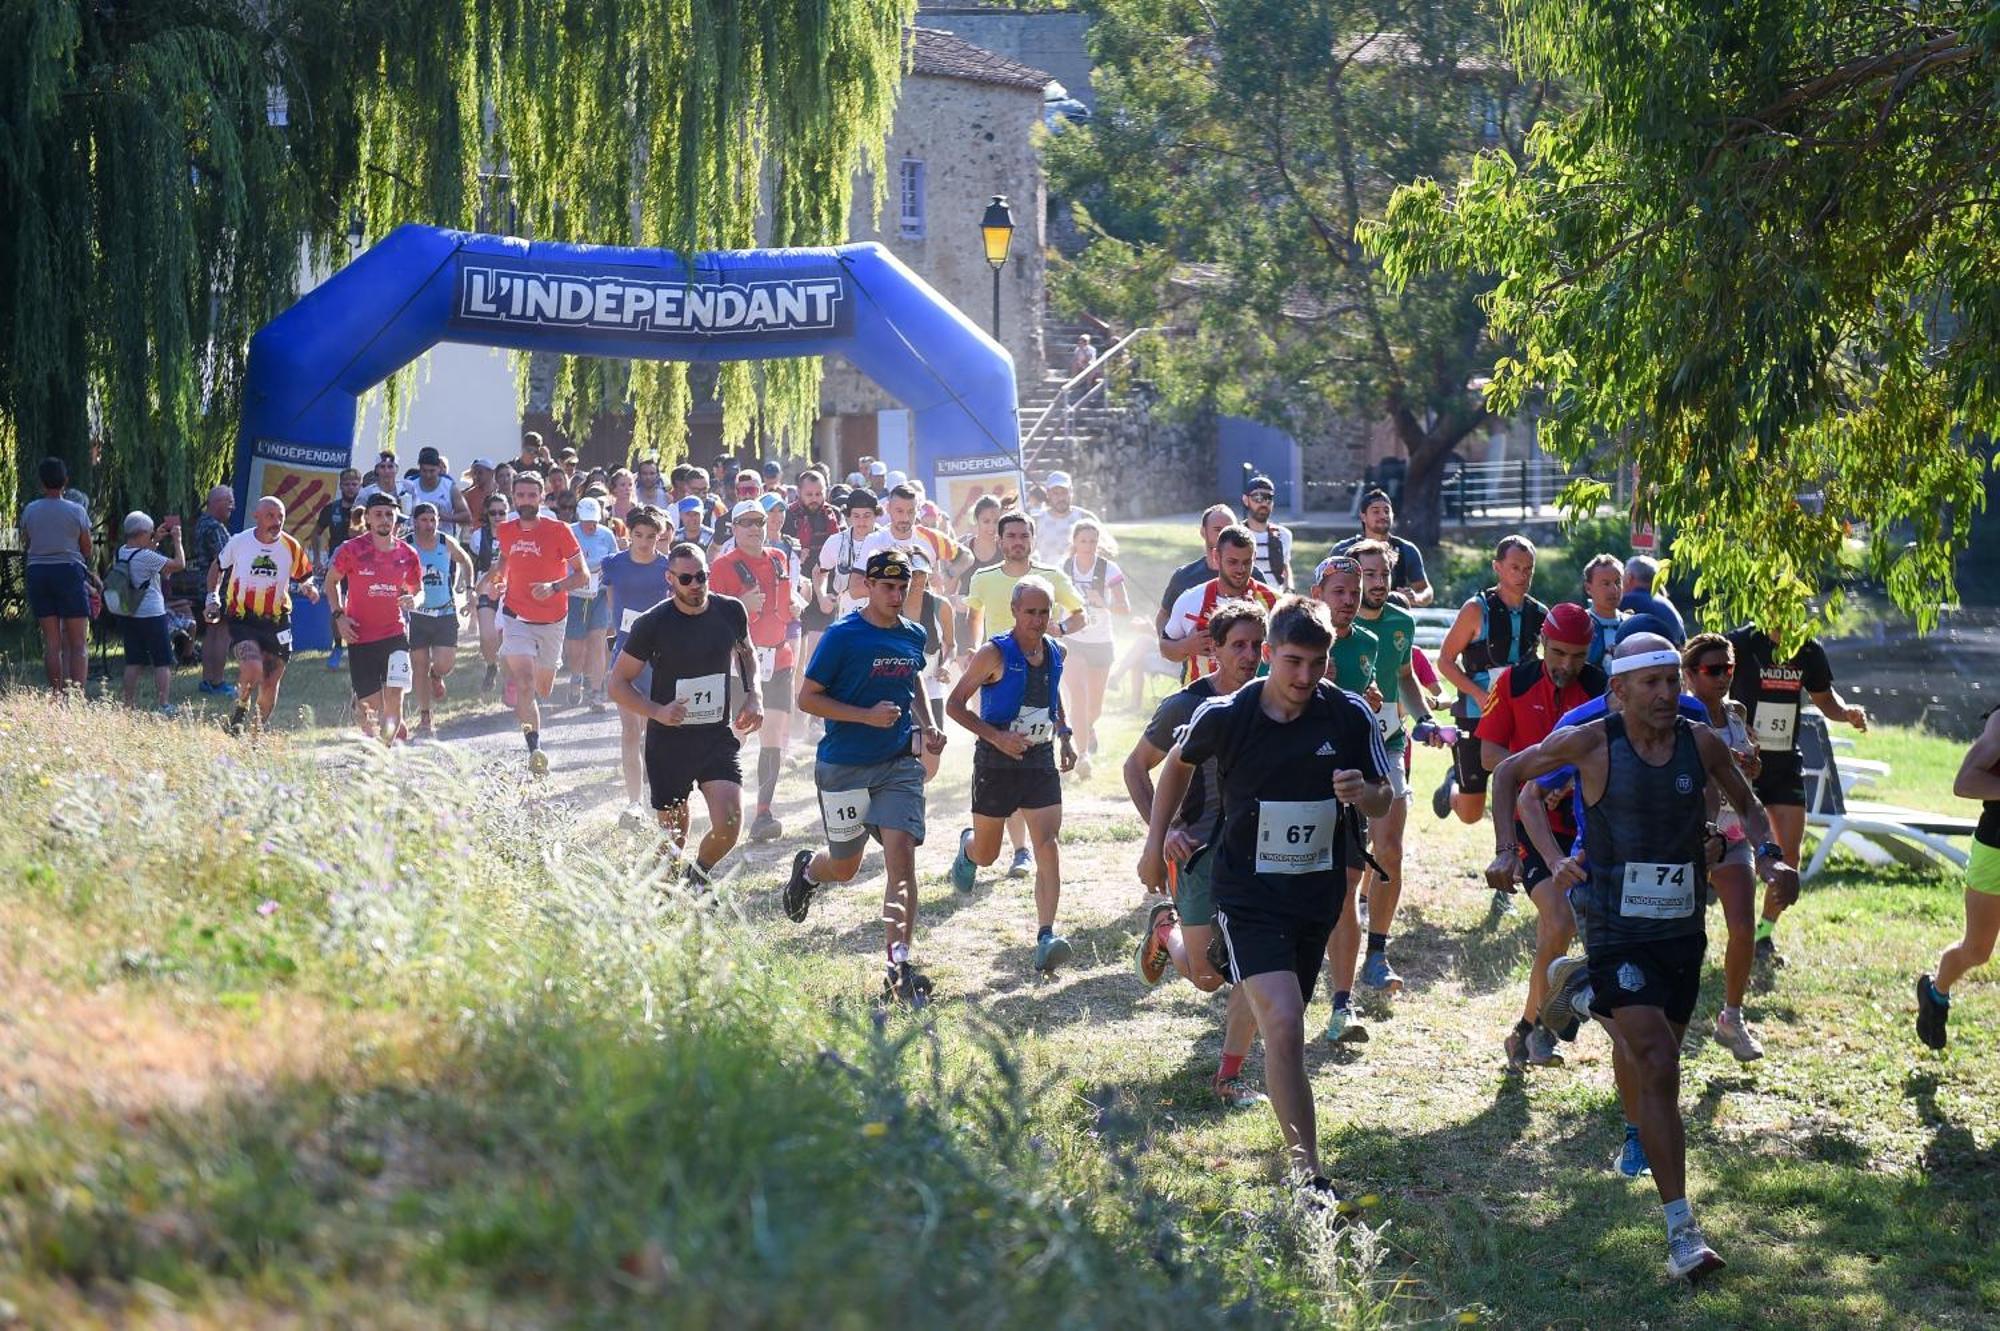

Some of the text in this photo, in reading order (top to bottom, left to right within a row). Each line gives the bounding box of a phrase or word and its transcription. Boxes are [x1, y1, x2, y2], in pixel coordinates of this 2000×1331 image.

[469, 273, 836, 327] L'INDÉPENDANT
[1760, 668, 1803, 680] MUD DAY
[694, 690, 712, 704] 71
[1030, 723, 1046, 735] 17
[1770, 718, 1786, 731] 53
[837, 806, 857, 820] 18
[1286, 825, 1316, 844] 67
[1656, 866, 1684, 886] 74
